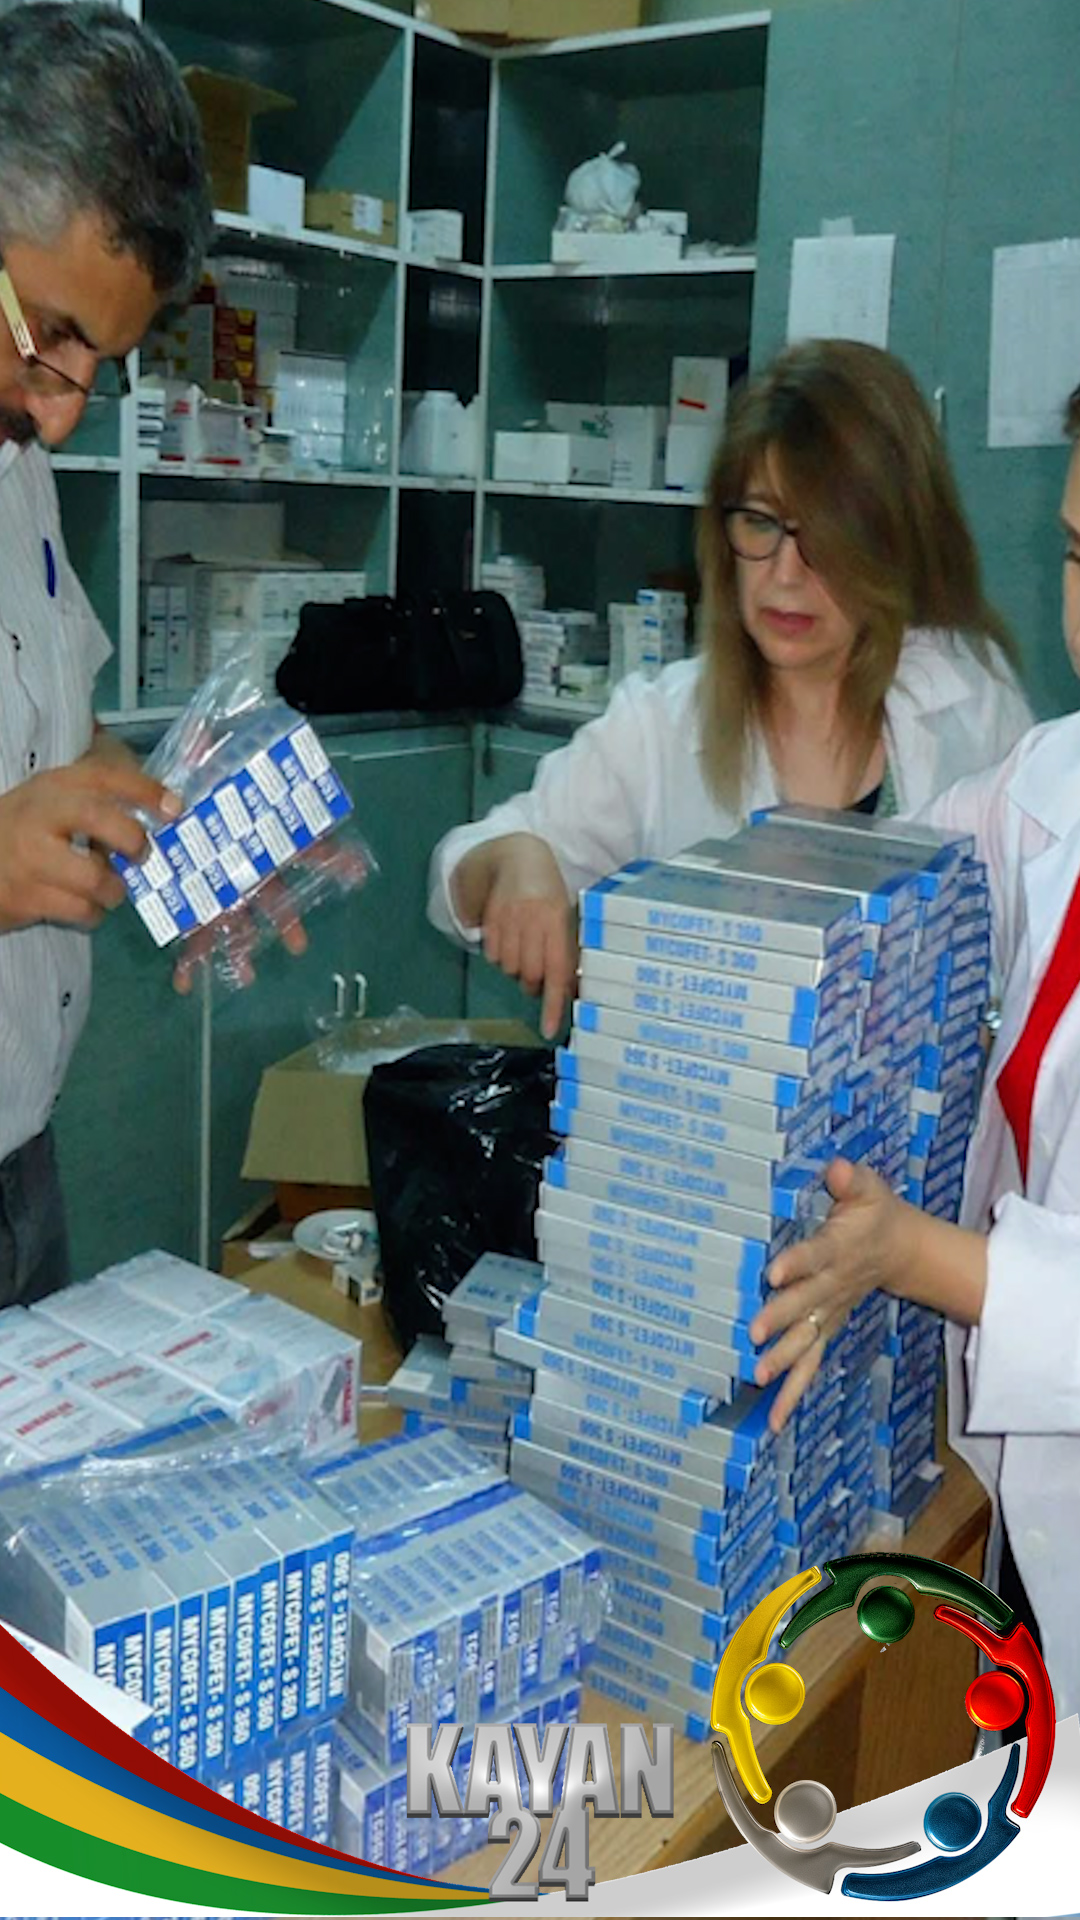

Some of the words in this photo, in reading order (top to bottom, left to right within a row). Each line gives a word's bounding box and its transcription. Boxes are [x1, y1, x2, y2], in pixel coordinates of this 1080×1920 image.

[235, 1592, 255, 1689] MYCOFET-
[259, 1579, 279, 1675] MYCOFET-
[283, 1569, 303, 1665] MYCOFET-
[179, 1614, 200, 1713] MYCOFET-
[207, 1605, 227, 1701] MYCOFET-
[232, 1706, 251, 1745] 360
[257, 1693, 275, 1731] 360
[281, 1682, 298, 1720] 360
[178, 1730, 197, 1770] 360
[205, 1720, 224, 1758] 360
